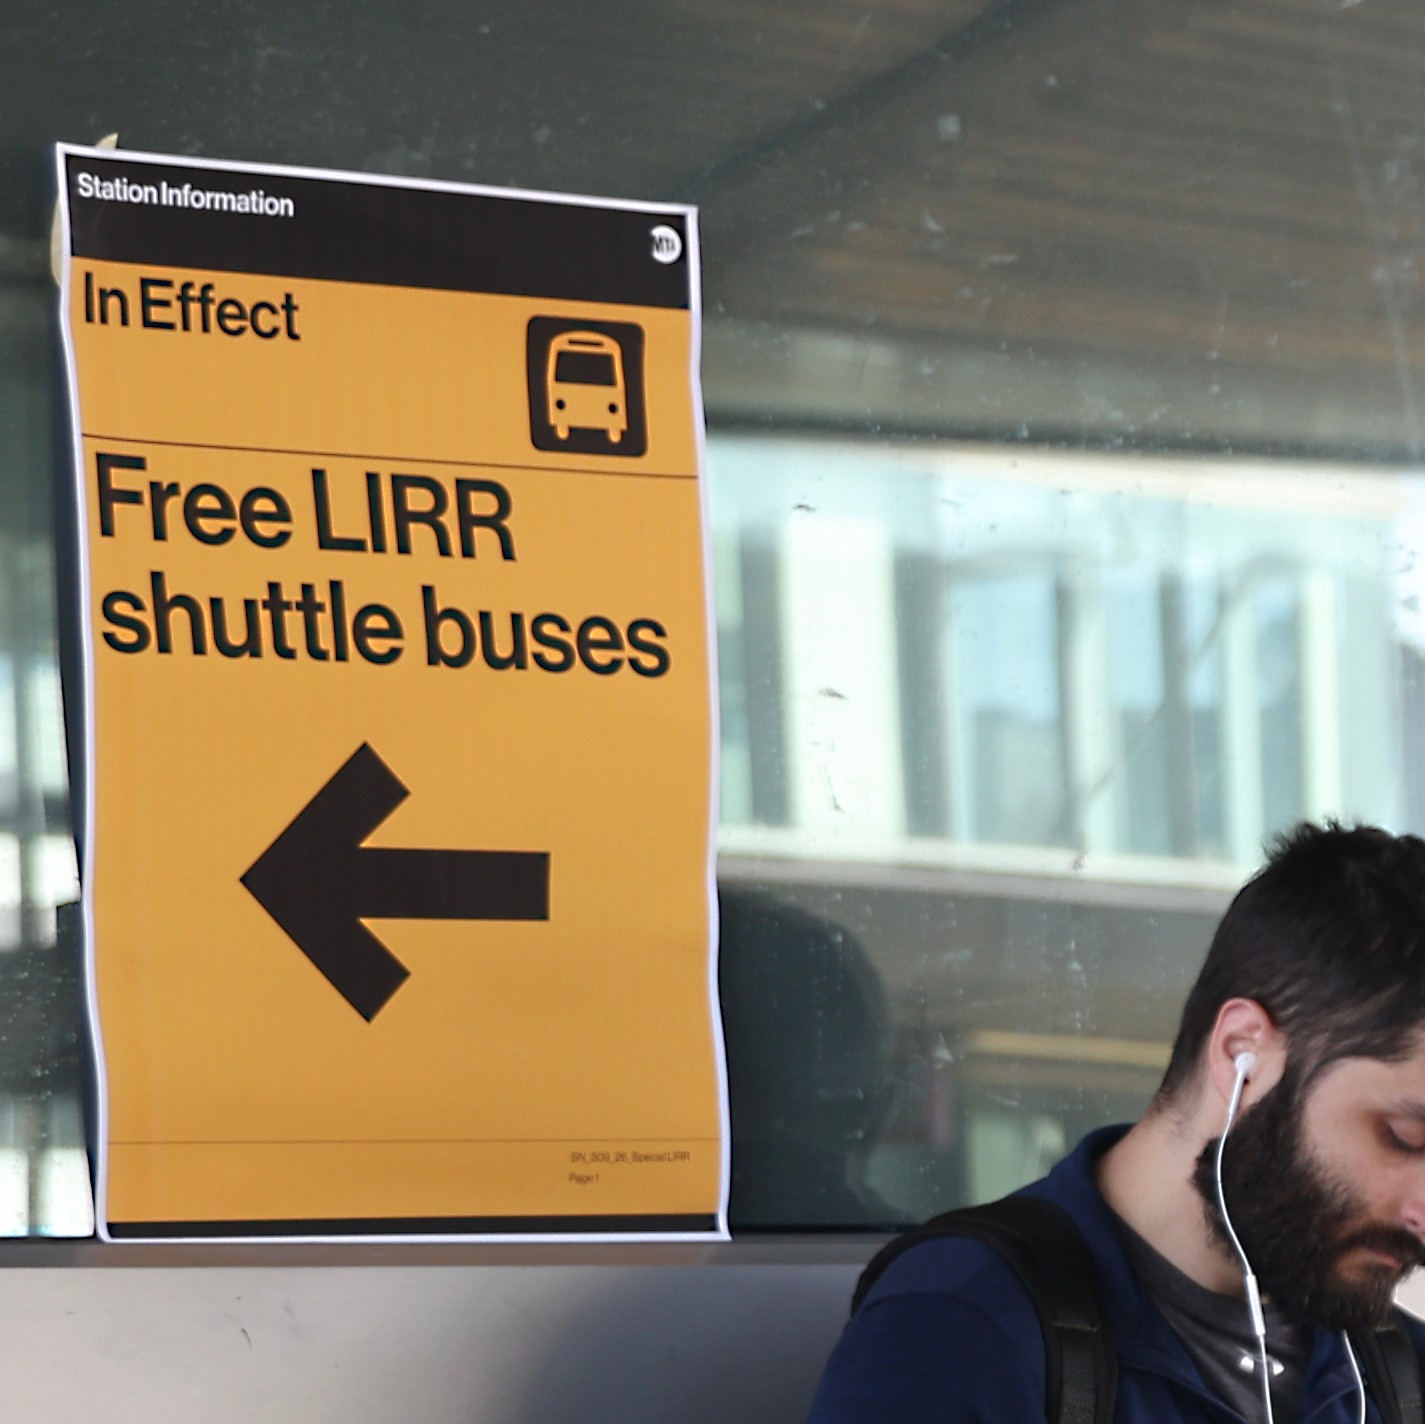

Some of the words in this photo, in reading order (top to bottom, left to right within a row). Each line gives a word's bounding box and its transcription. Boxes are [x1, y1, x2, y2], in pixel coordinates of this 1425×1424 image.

[77, 172, 159, 205] Station
[160, 181, 295, 218] Information
[84, 271, 129, 327] In
[139, 277, 301, 341] Effect
[95, 452, 293, 549] Free
[311, 468, 517, 561] LIRR
[101, 570, 405, 666] shuttle
[421, 585, 671, 679] buses
